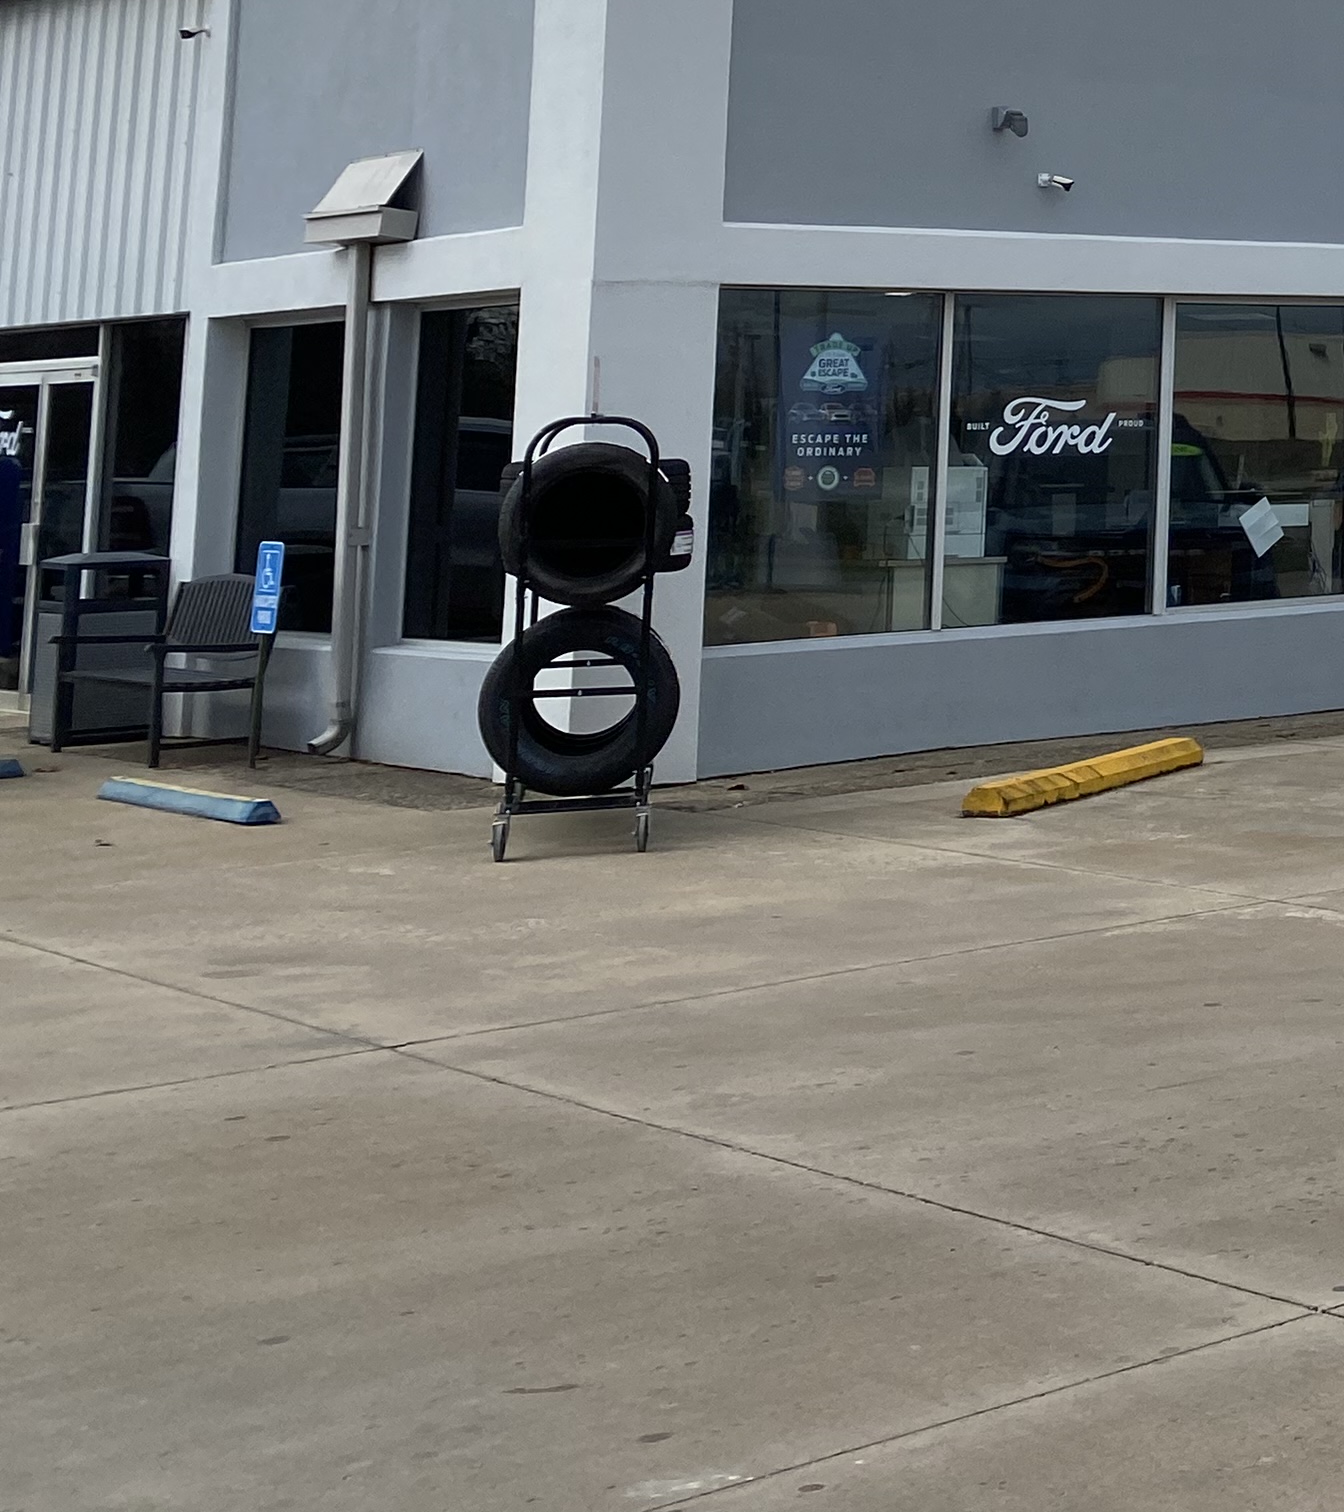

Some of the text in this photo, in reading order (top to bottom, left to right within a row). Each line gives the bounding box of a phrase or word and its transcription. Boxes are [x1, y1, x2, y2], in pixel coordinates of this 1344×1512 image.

[818, 358, 850, 368] GREAT
[818, 368, 849, 377] ESCAPE
[966, 397, 1144, 455] BUILT Ford PROUD
[791, 434, 868, 444] ESCAPE THE
[797, 447, 862, 457] ORDINARY
